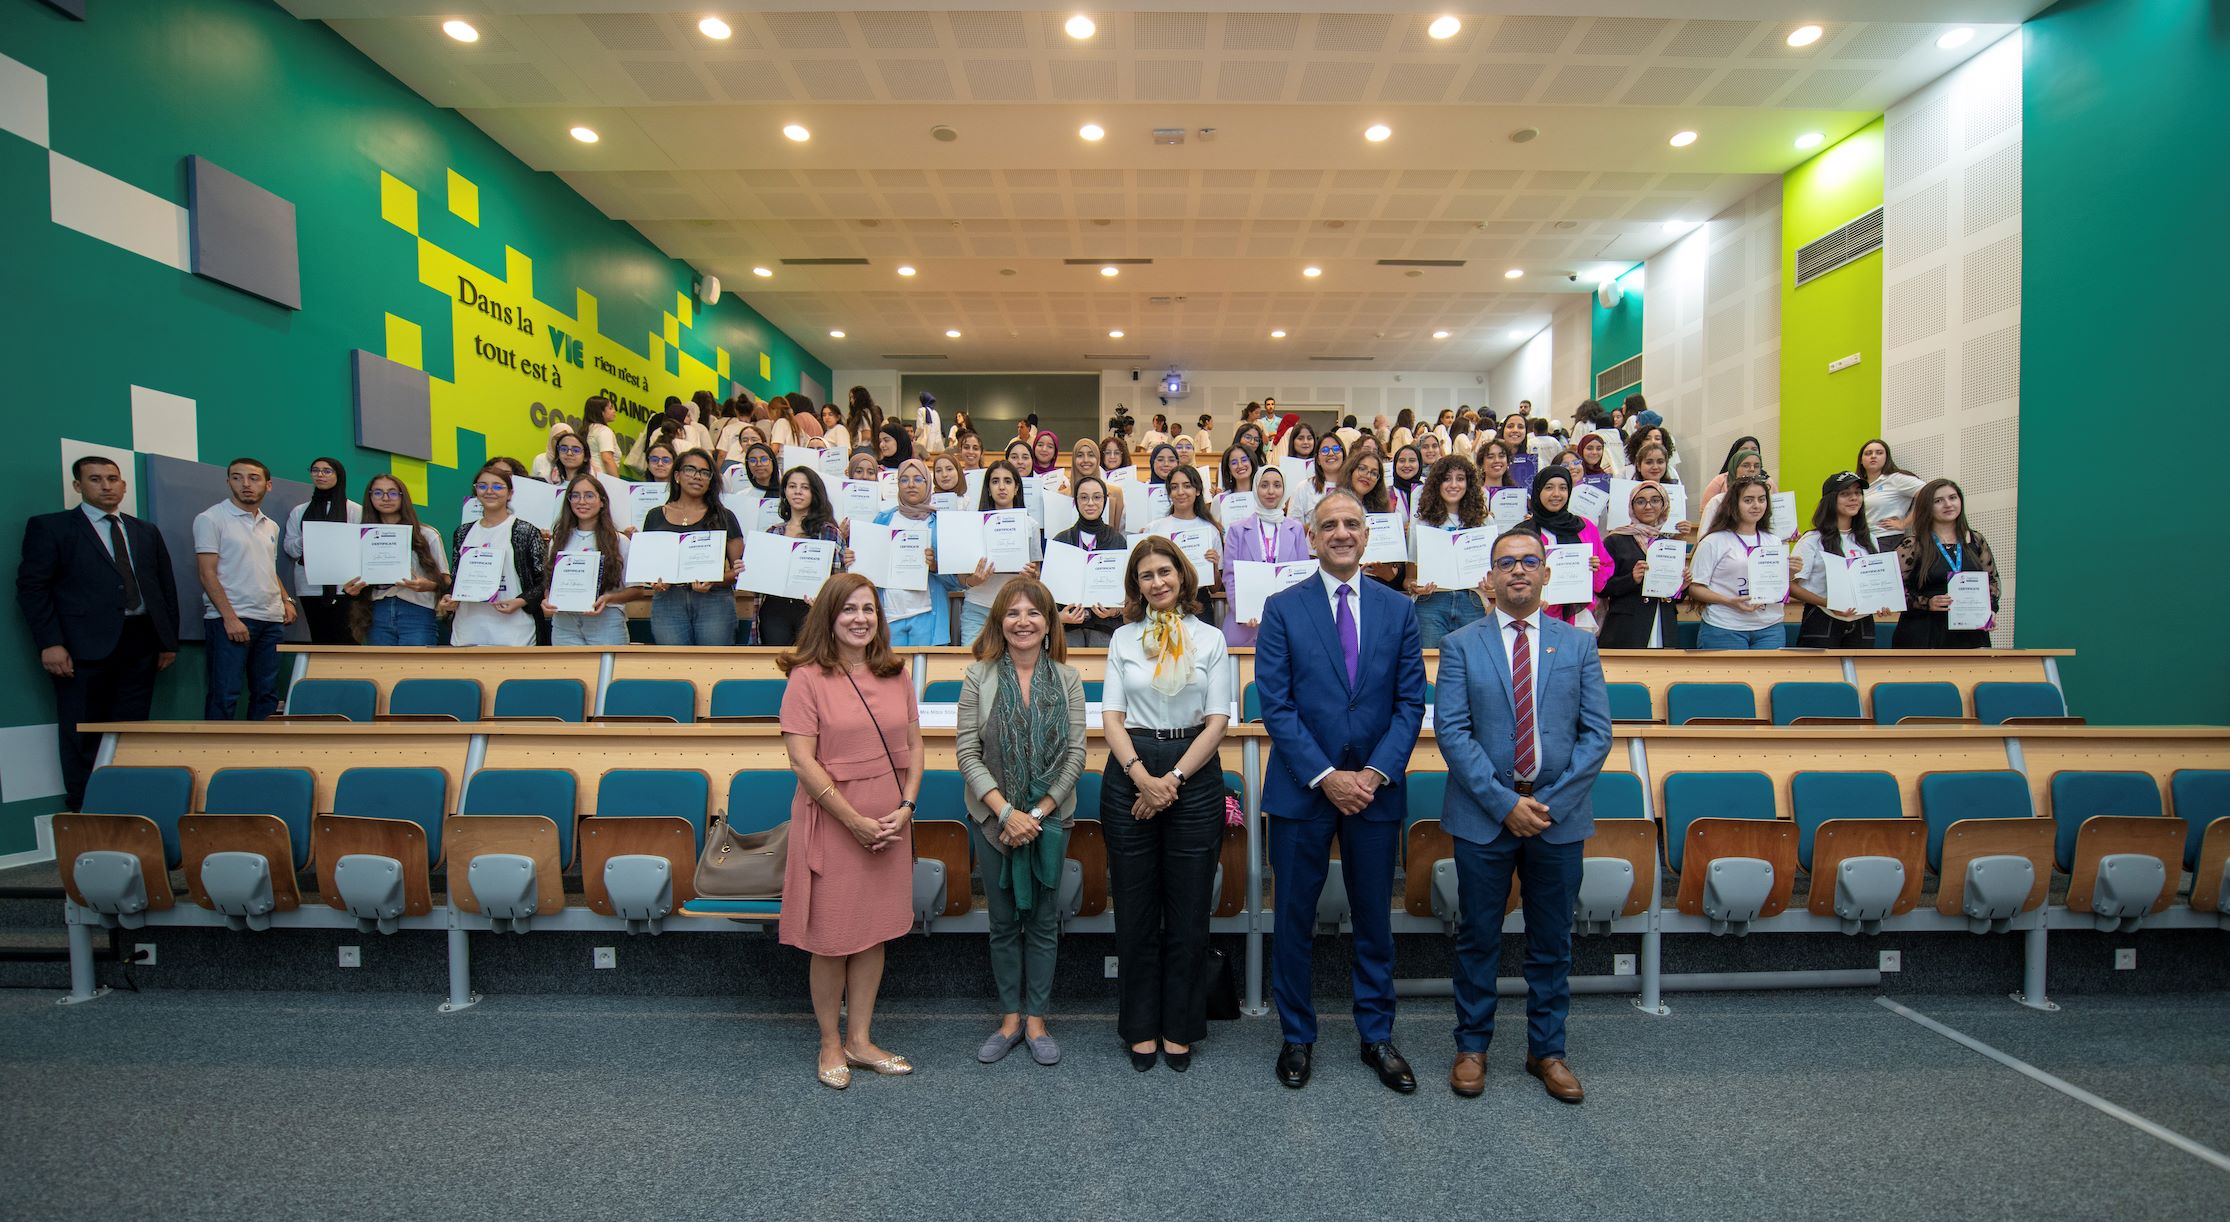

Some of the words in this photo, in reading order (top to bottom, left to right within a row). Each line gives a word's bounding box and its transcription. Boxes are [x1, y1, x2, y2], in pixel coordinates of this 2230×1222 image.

[458, 275, 513, 325] Dans
[517, 306, 534, 336] la
[547, 324, 584, 369] VIE
[594, 355, 616, 376] rien
[643, 376, 649, 392] à
[474, 334, 517, 370] tout
[520, 358, 548, 382] est
[551, 364, 562, 388] à
[600, 388, 656, 424] CRAIND
